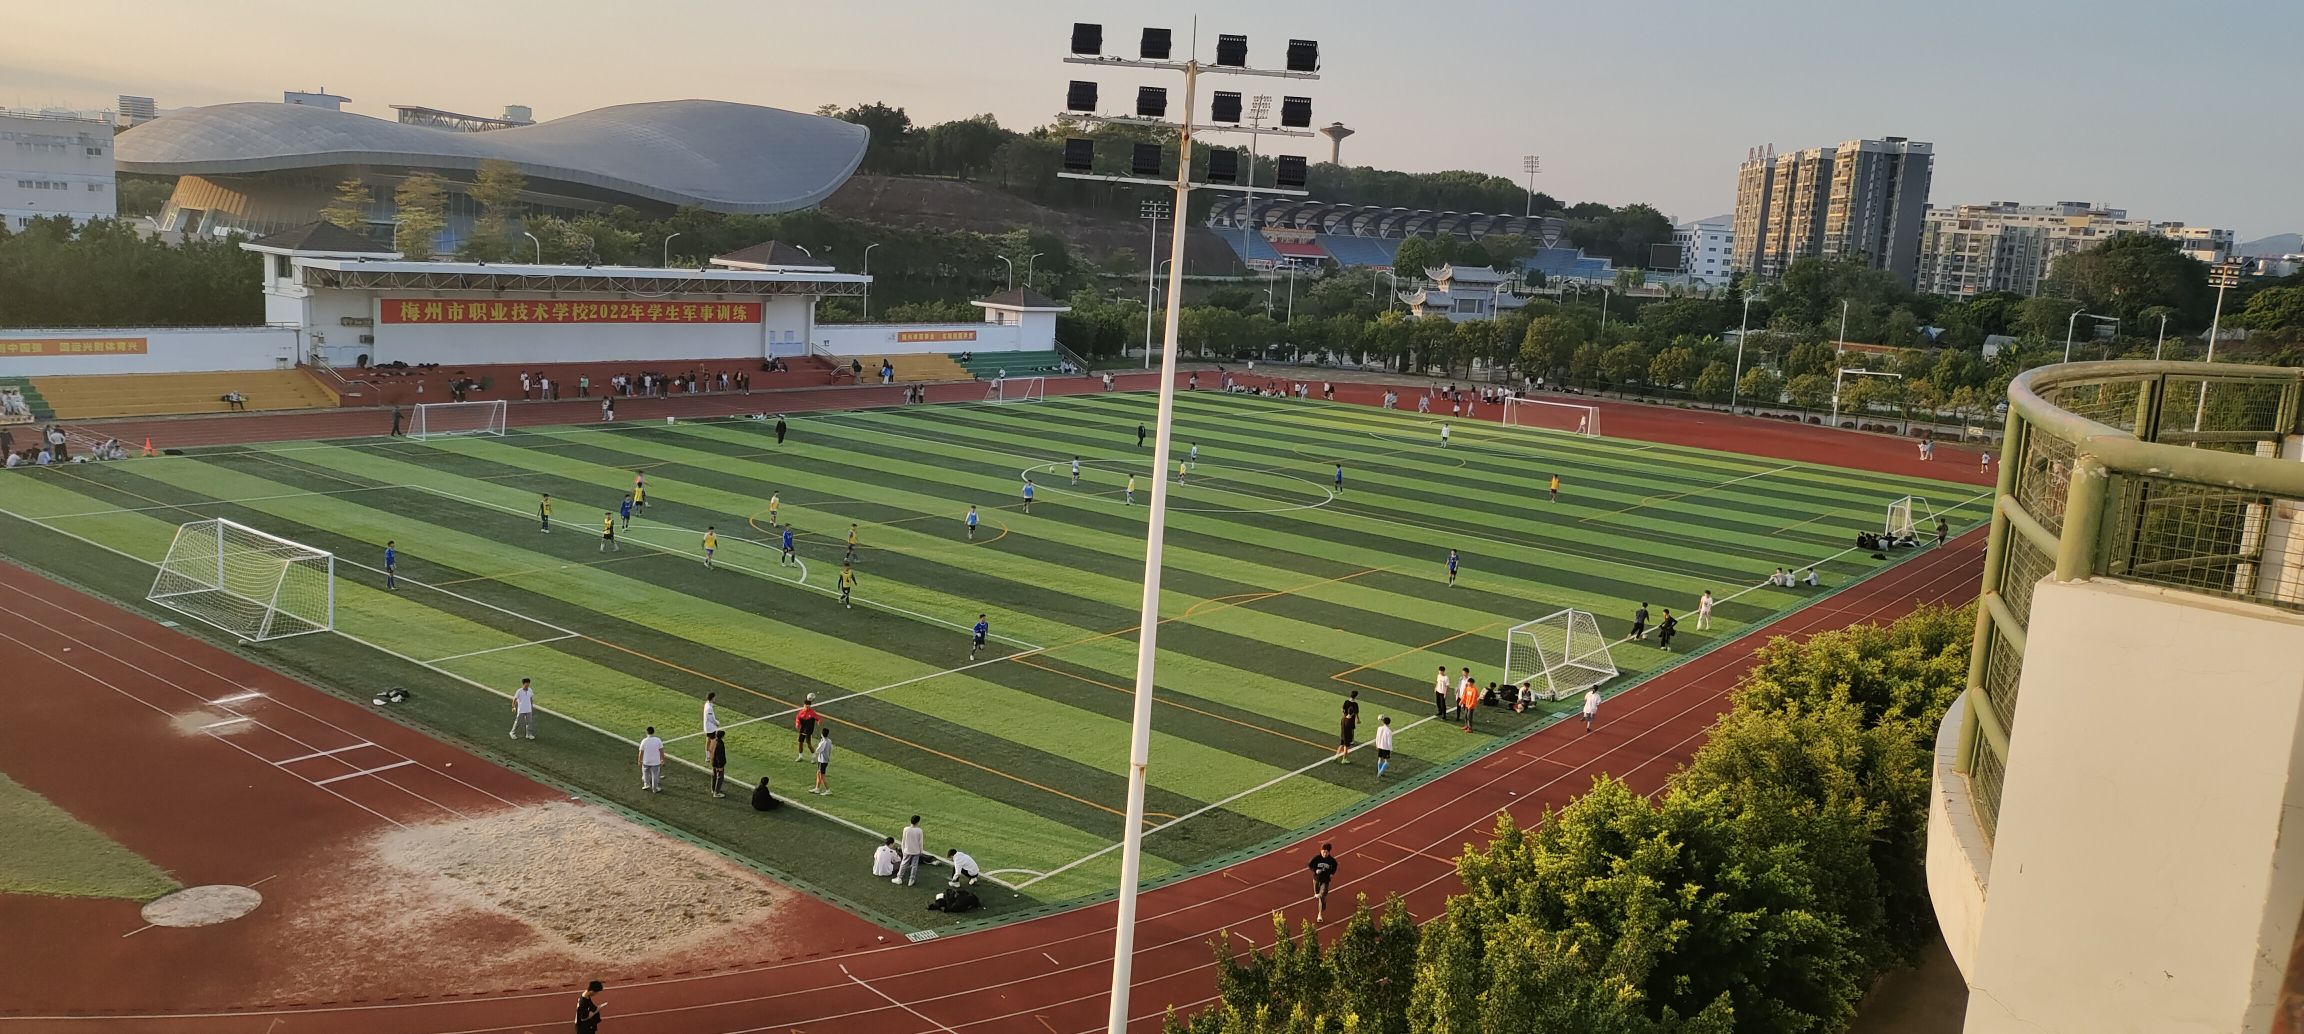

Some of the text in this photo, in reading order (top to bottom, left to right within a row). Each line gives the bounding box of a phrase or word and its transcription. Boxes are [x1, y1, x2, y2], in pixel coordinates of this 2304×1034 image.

[400, 302, 748, 322] 梅州市职业技术学校2022年学生军事训练
